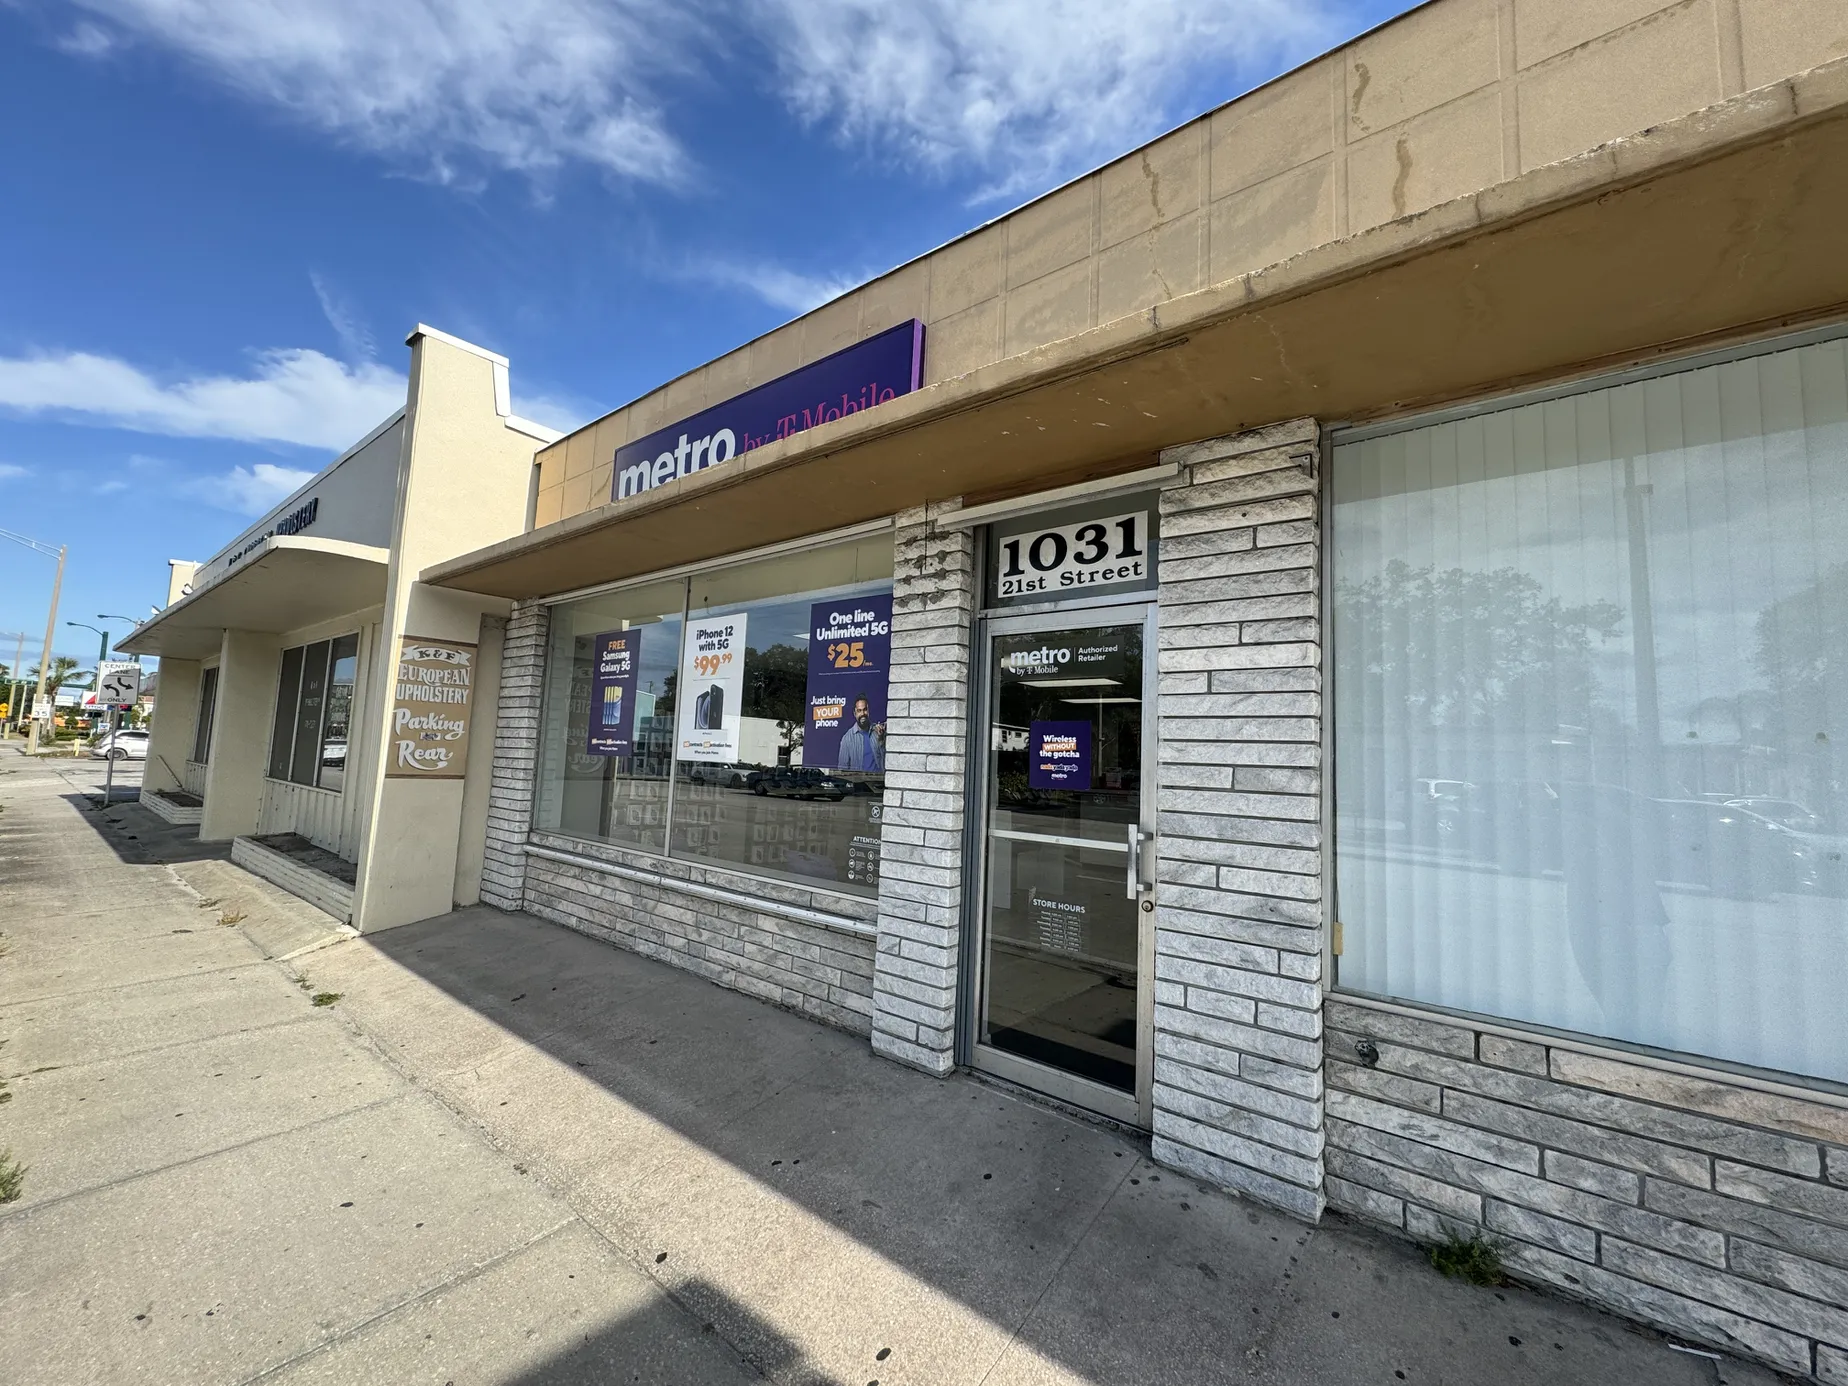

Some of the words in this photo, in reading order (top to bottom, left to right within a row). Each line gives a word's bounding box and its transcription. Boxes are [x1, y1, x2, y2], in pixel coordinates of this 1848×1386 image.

[618, 428, 736, 500] metro
[1003, 516, 1143, 577] 1031
[1002, 576, 1047, 595] 21st
[1060, 561, 1143, 587] Street
[829, 612, 853, 626] One
[854, 609, 875, 623] line
[696, 629, 724, 640] iPhone
[724, 625, 734, 637] 12
[816, 622, 869, 641] Unlimited
[871, 621, 888, 636] 5G
[608, 640, 626, 650] FREE
[699, 640, 716, 652] with
[717, 638, 729, 650] 5G
[1078, 644, 1118, 655] Authorized
[602, 650, 630, 661] Samsung
[1010, 646, 1071, 666] metro
[1078, 654, 1106, 662] Retailer
[600, 662, 620, 673] Galaxy
[621, 661, 631, 671] 5G
[1016, 667, 1026, 677] by
[398, 664, 472, 687] EUROPEAN
[396, 683, 470, 705] UPHOLSTERY
[810, 695, 826, 706] Just
[827, 695, 846, 706] bring
[816, 707, 840, 718] YOUR
[392, 708, 465, 740] Parking
[815, 718, 838, 730] phone
[1043, 734, 1077, 743] Wireless
[395, 740, 454, 771] Rear
[1053, 751, 1080, 759] gotcha
[1032, 898, 1057, 909] STORE
[1058, 902, 1086, 914] HOURS
